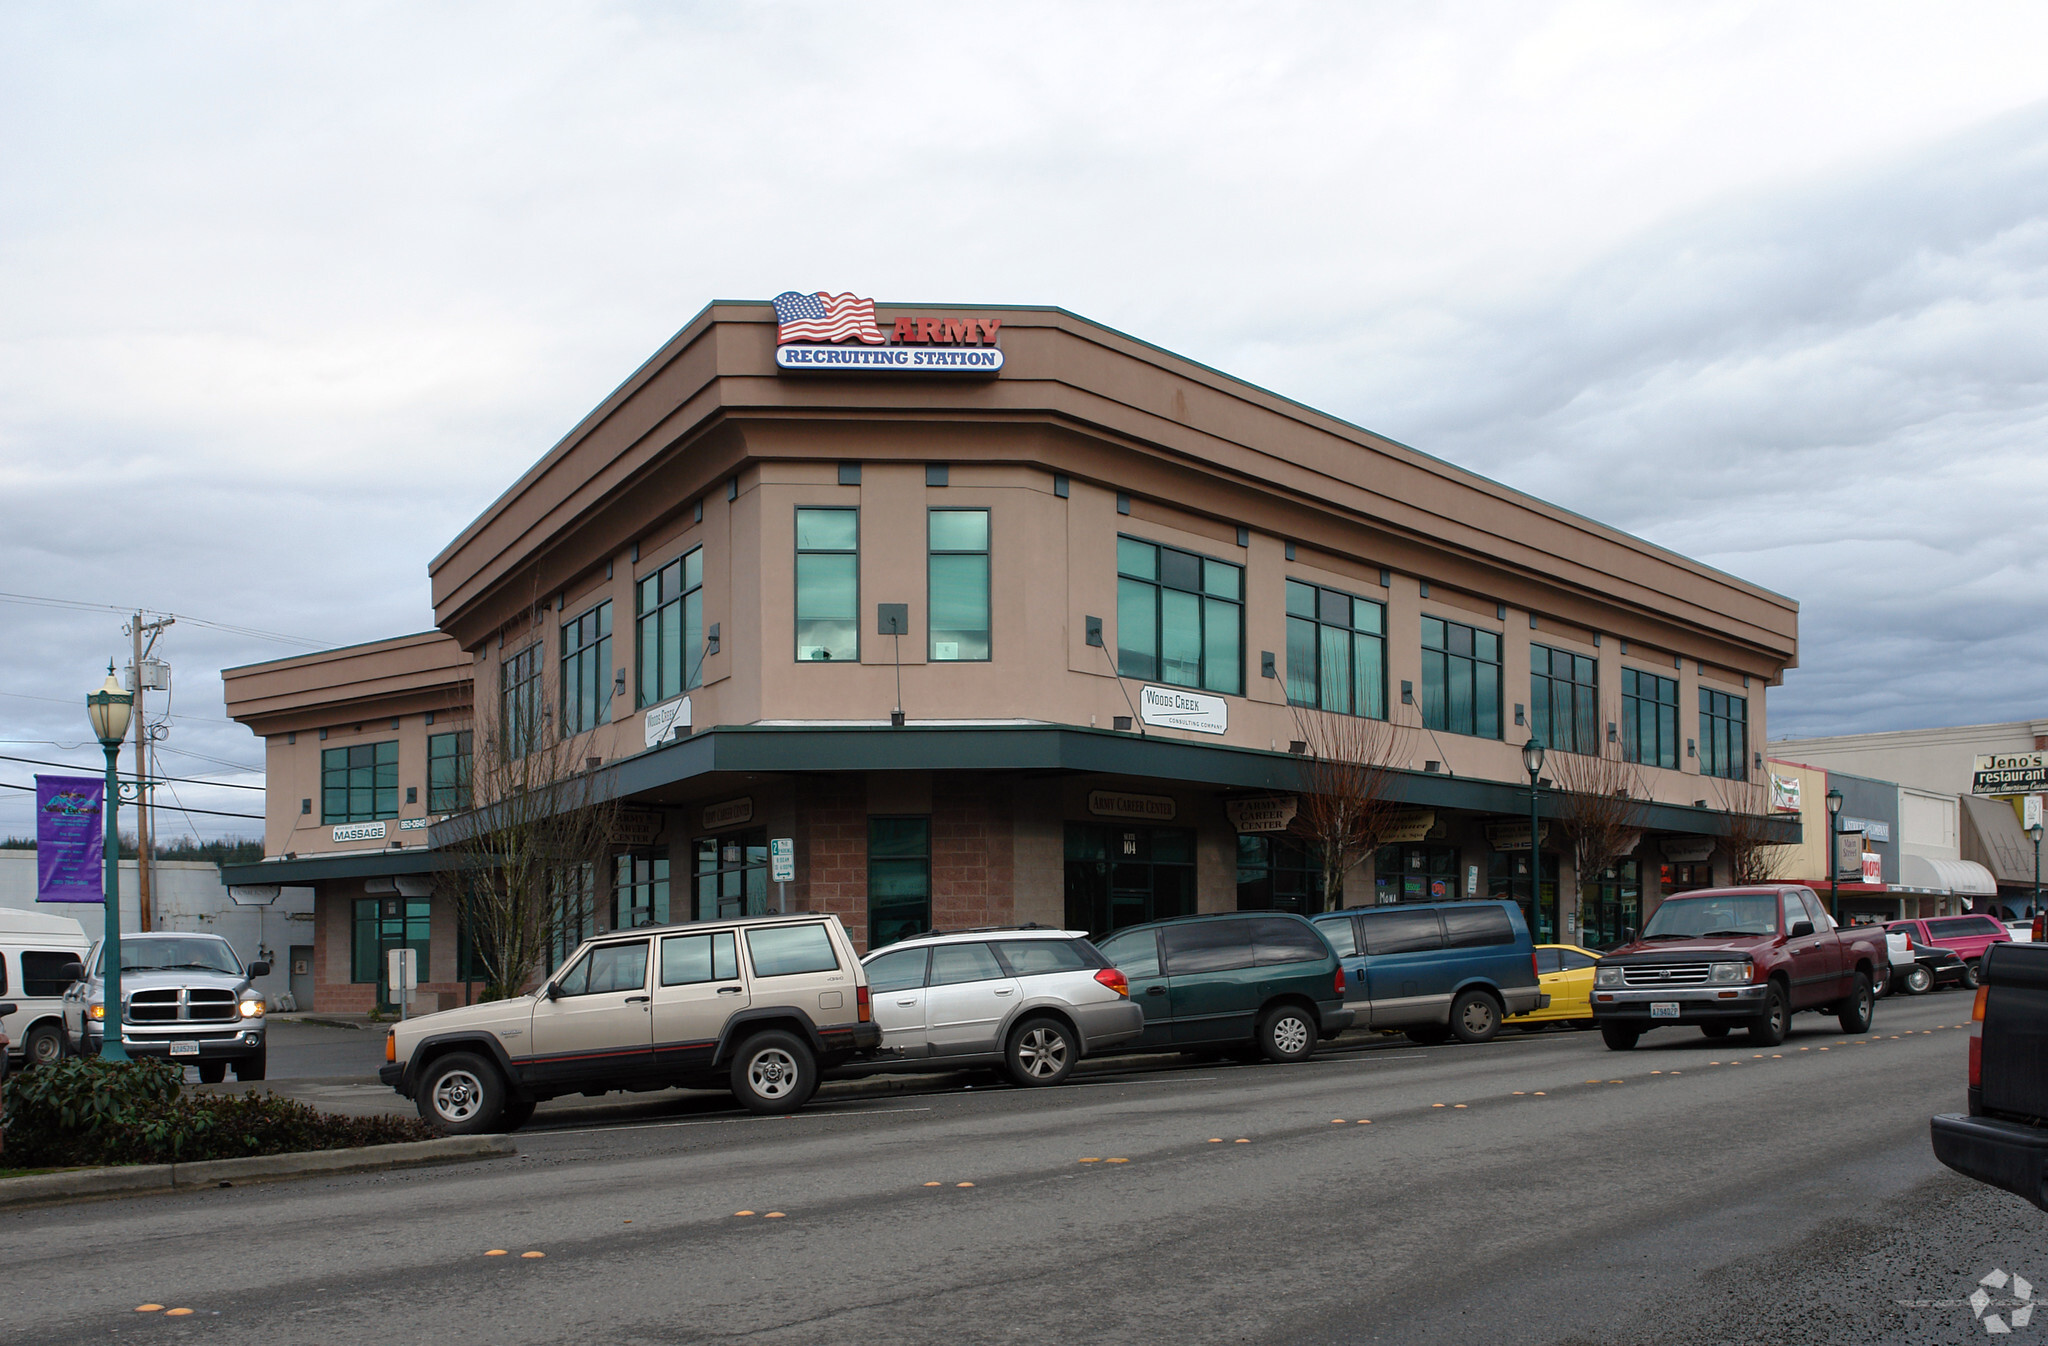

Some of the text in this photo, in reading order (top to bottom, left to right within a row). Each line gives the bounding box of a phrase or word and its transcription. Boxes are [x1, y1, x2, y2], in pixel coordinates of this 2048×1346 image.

[891, 317, 1002, 345] ARMY
[785, 349, 996, 366] RECRUITING STATION
[1168, 717, 1223, 730] CONSULTING COMPANY
[1984, 754, 2042, 770] Jeno's
[1979, 768, 2046, 784] restaurant
[1094, 796, 1172, 815] ARMY CAREER CENTER
[1247, 801, 1277, 810] ARMY
[1240, 811, 1283, 821] CAREER
[1241, 821, 1282, 831] CENTER
[334, 827, 384, 840] MASSAGE
[1123, 841, 1136, 854] 104
[1842, 847, 1857, 858] Street
